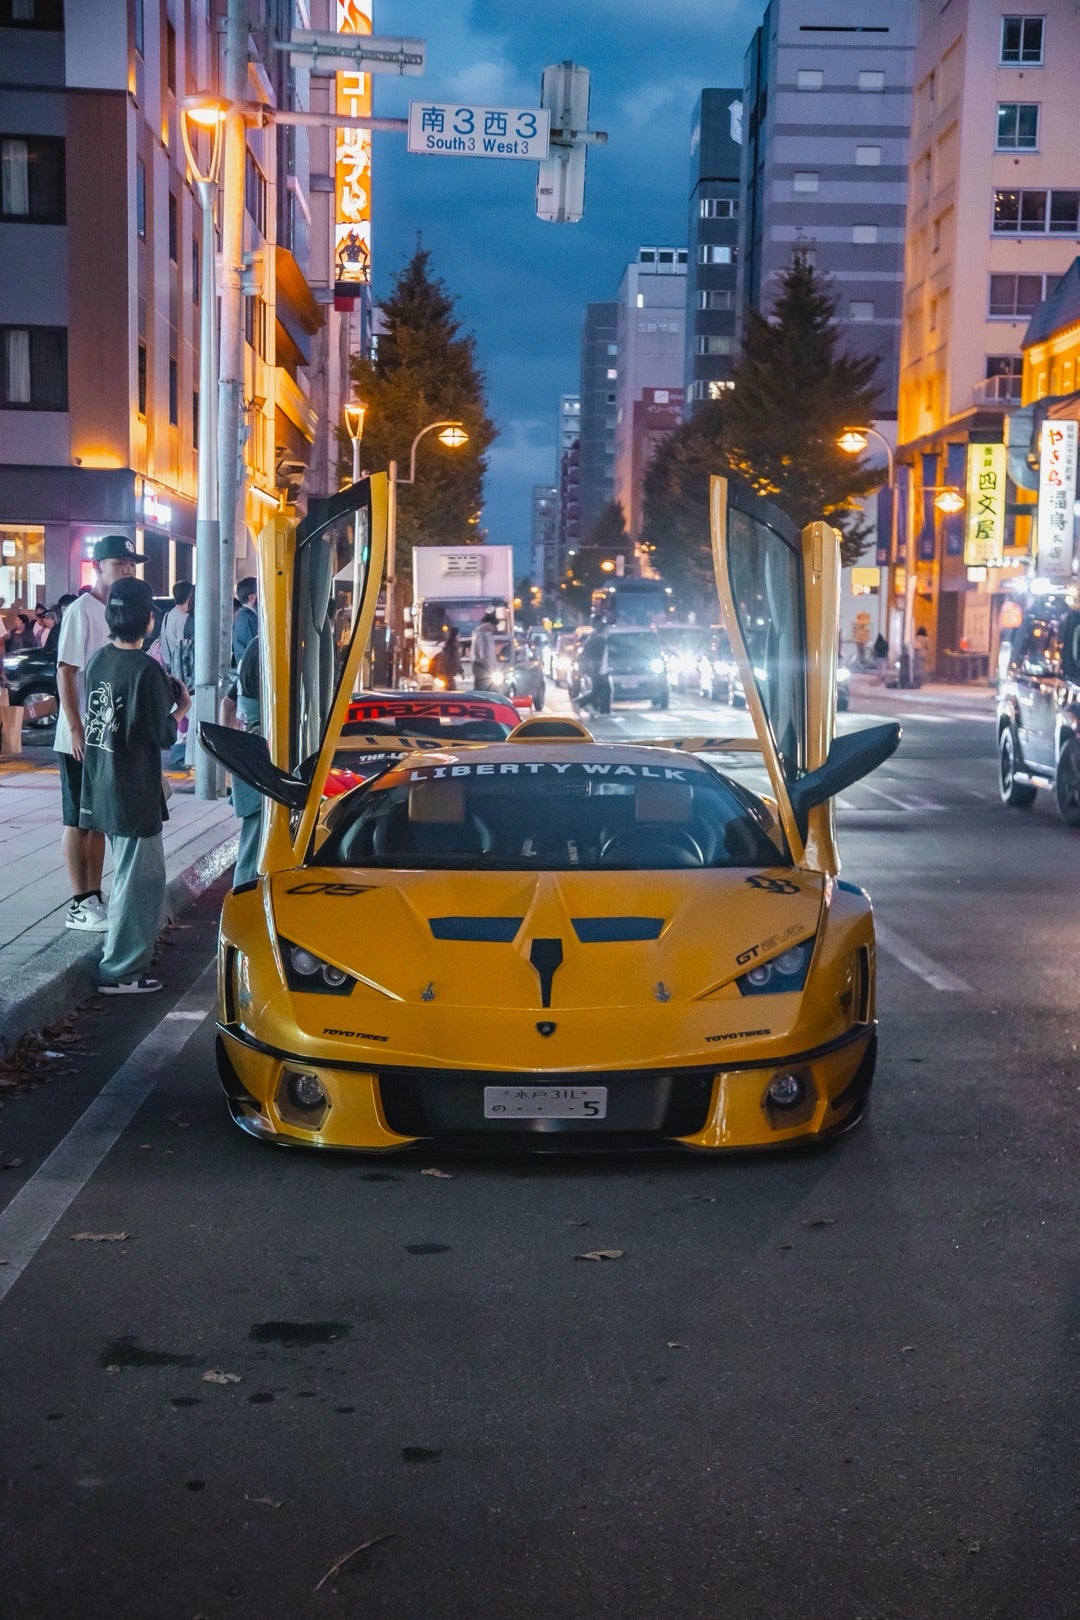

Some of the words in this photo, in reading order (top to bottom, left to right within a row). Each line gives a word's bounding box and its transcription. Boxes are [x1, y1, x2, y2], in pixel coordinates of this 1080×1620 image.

[409, 763, 572, 782] LIBERTY
[581, 763, 688, 782] WALK
[735, 944, 760, 966] GT
[322, 1028, 355, 1038] TOYO
[355, 1033, 390, 1042] TIRES
[704, 1031, 739, 1043] TOYO
[738, 1028, 771, 1038] TIRES
